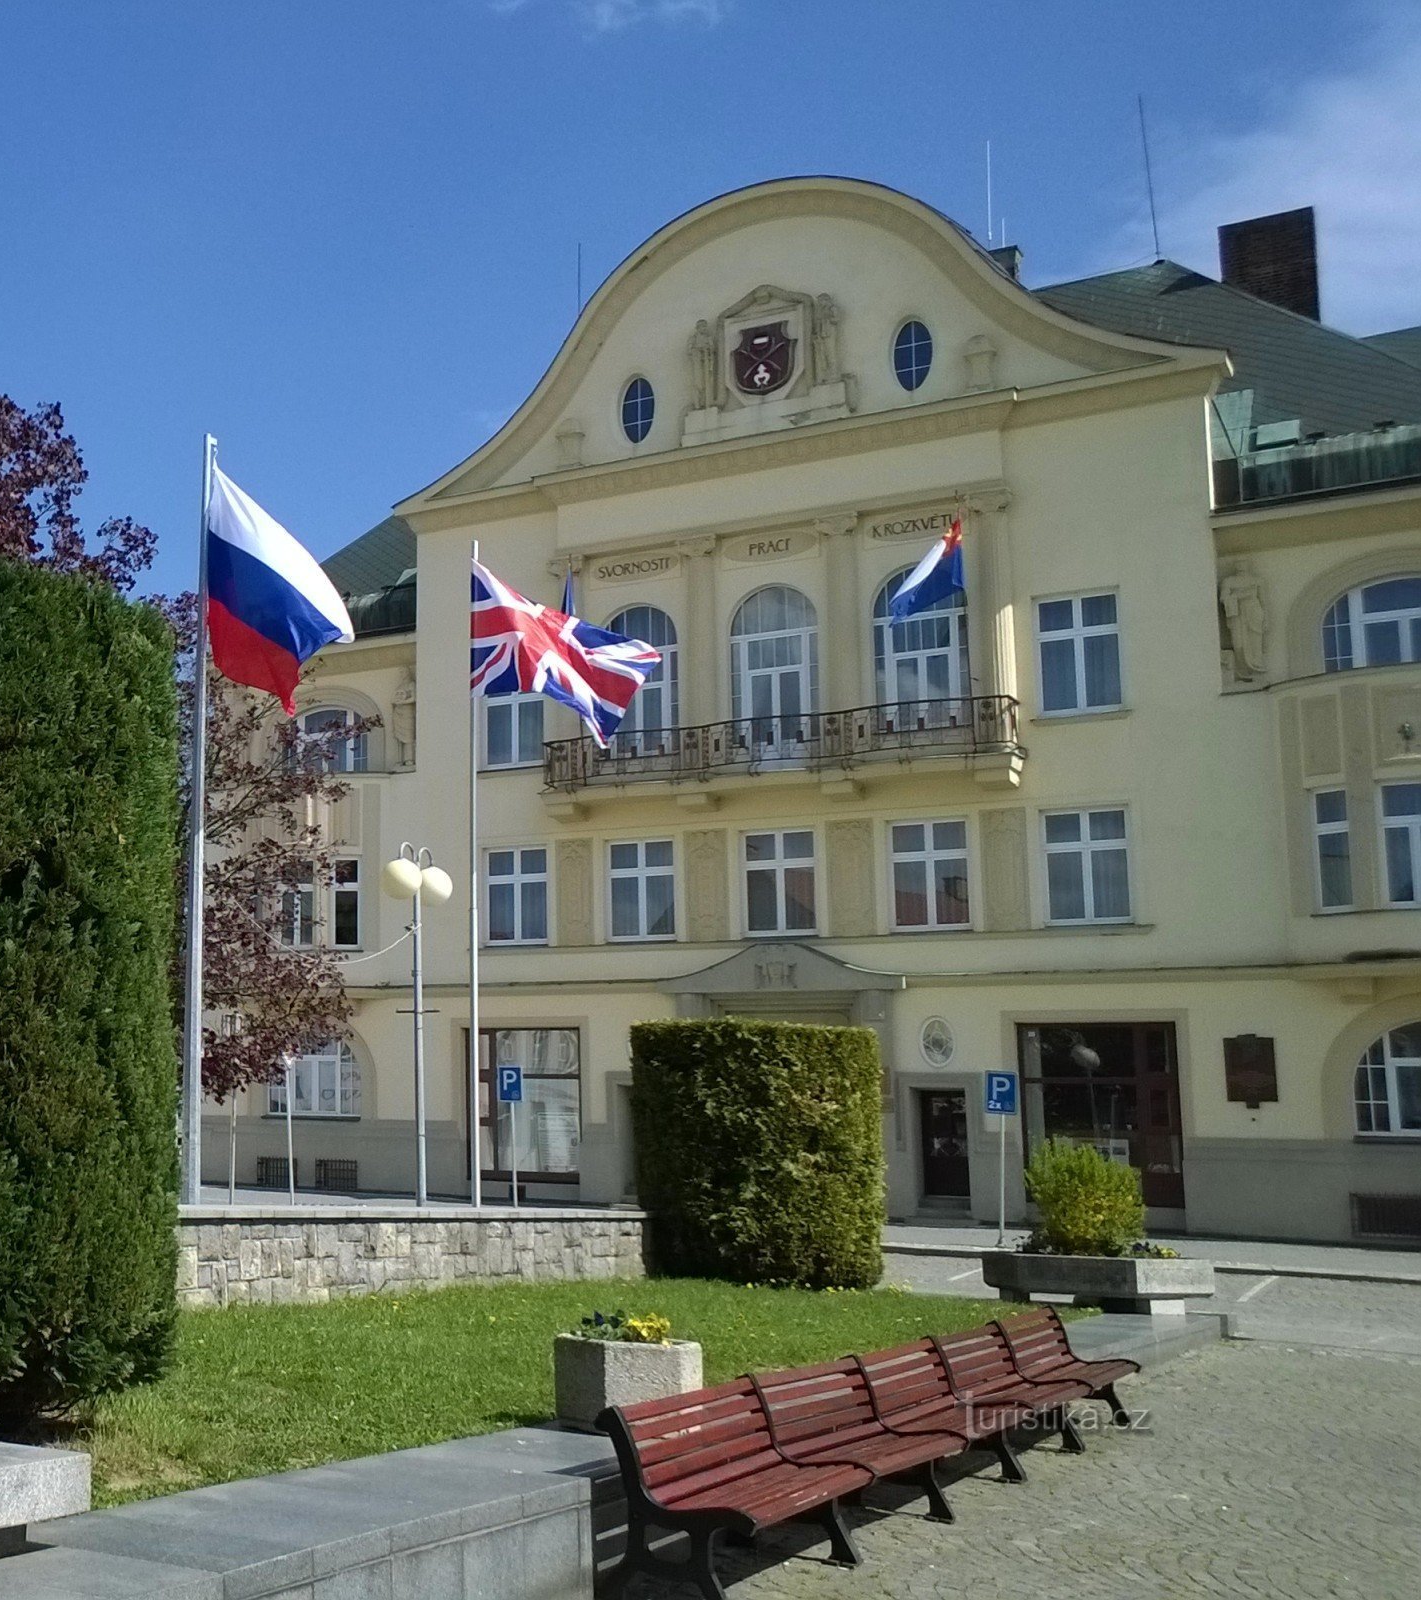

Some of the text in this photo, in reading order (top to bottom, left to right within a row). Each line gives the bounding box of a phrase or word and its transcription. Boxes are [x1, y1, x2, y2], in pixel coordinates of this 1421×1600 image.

[872, 525, 882, 538] K
[502, 1070, 517, 1091] P
[992, 1076, 1011, 1100] P
[988, 1100, 1002, 1110] 2x
